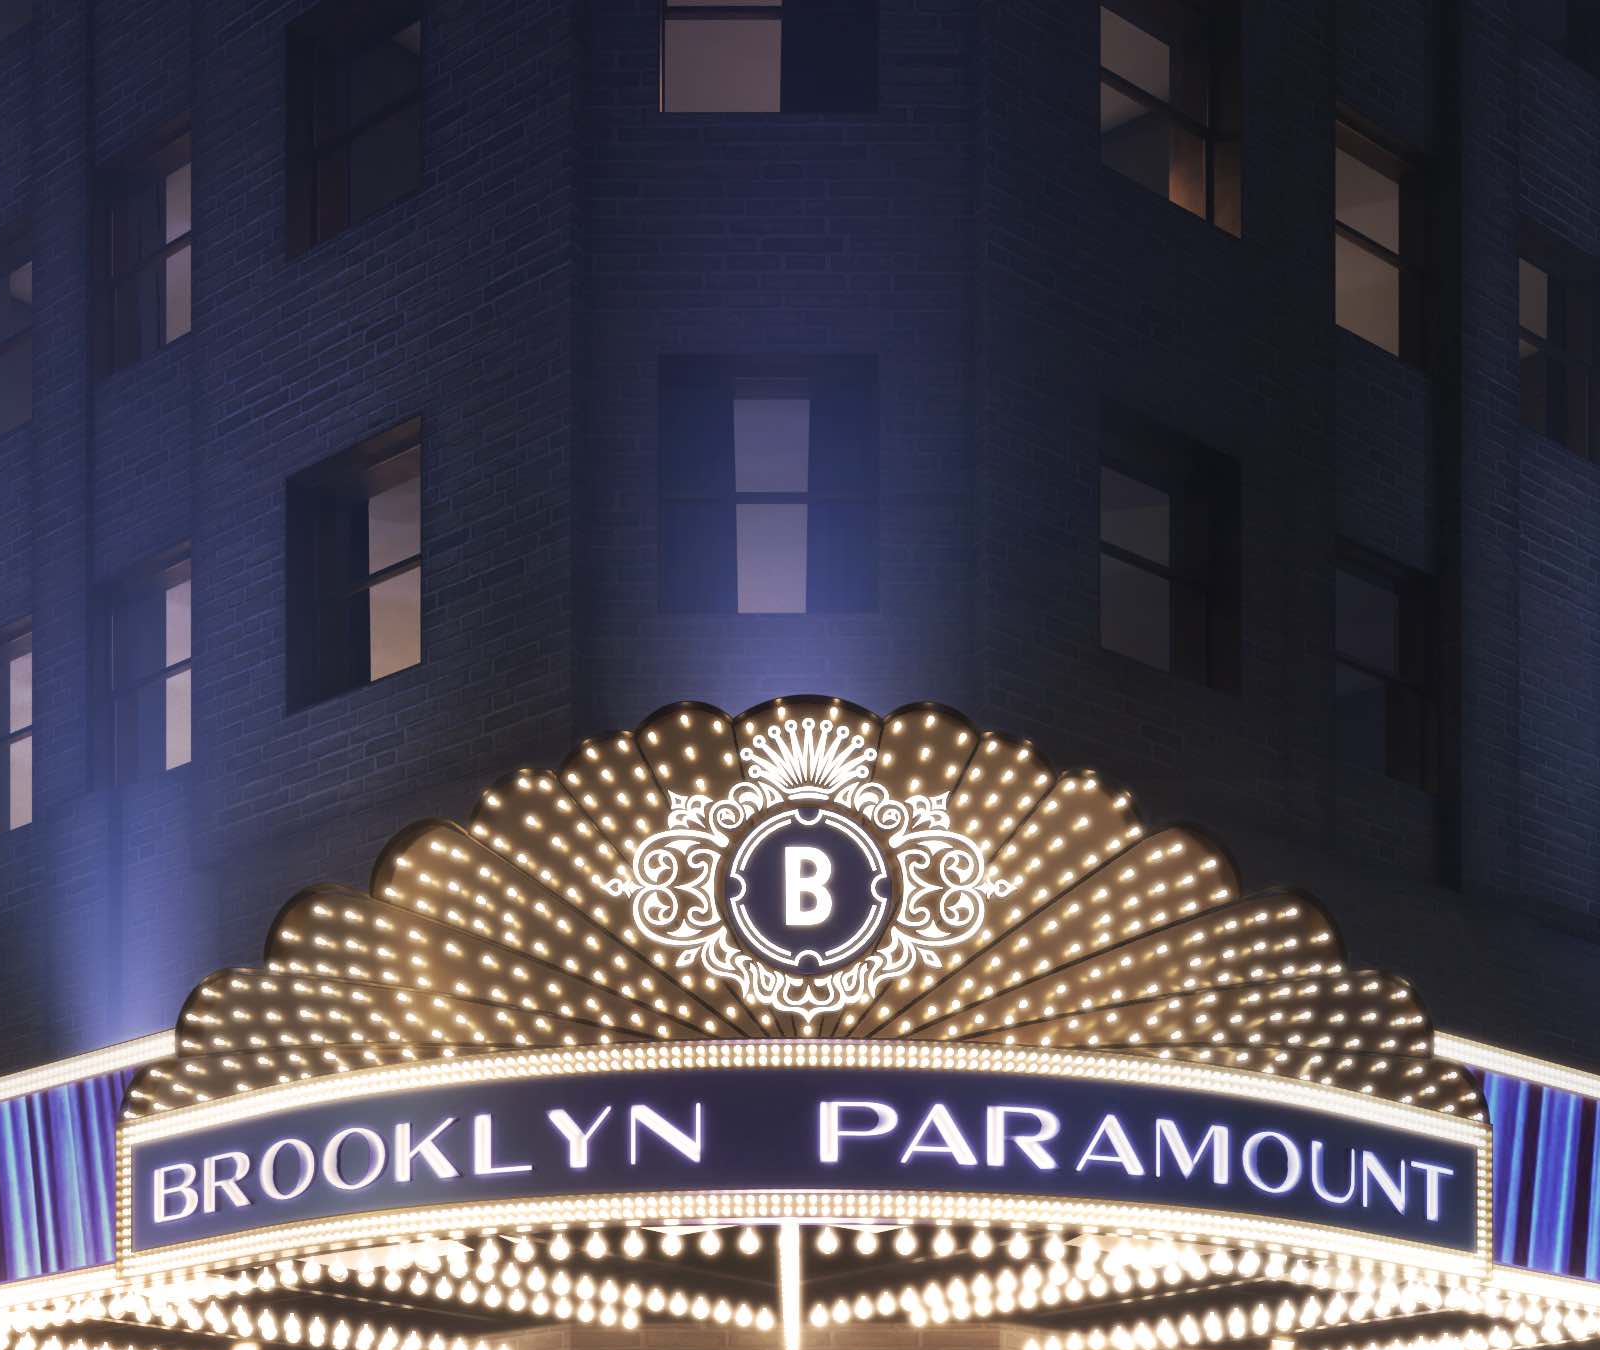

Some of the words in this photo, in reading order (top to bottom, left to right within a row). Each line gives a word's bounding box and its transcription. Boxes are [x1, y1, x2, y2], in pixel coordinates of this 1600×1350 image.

[784, 846, 833, 926] B
[151, 1102, 705, 1224] BROOKLYN
[816, 1101, 1456, 1223] PARAMOUNT
